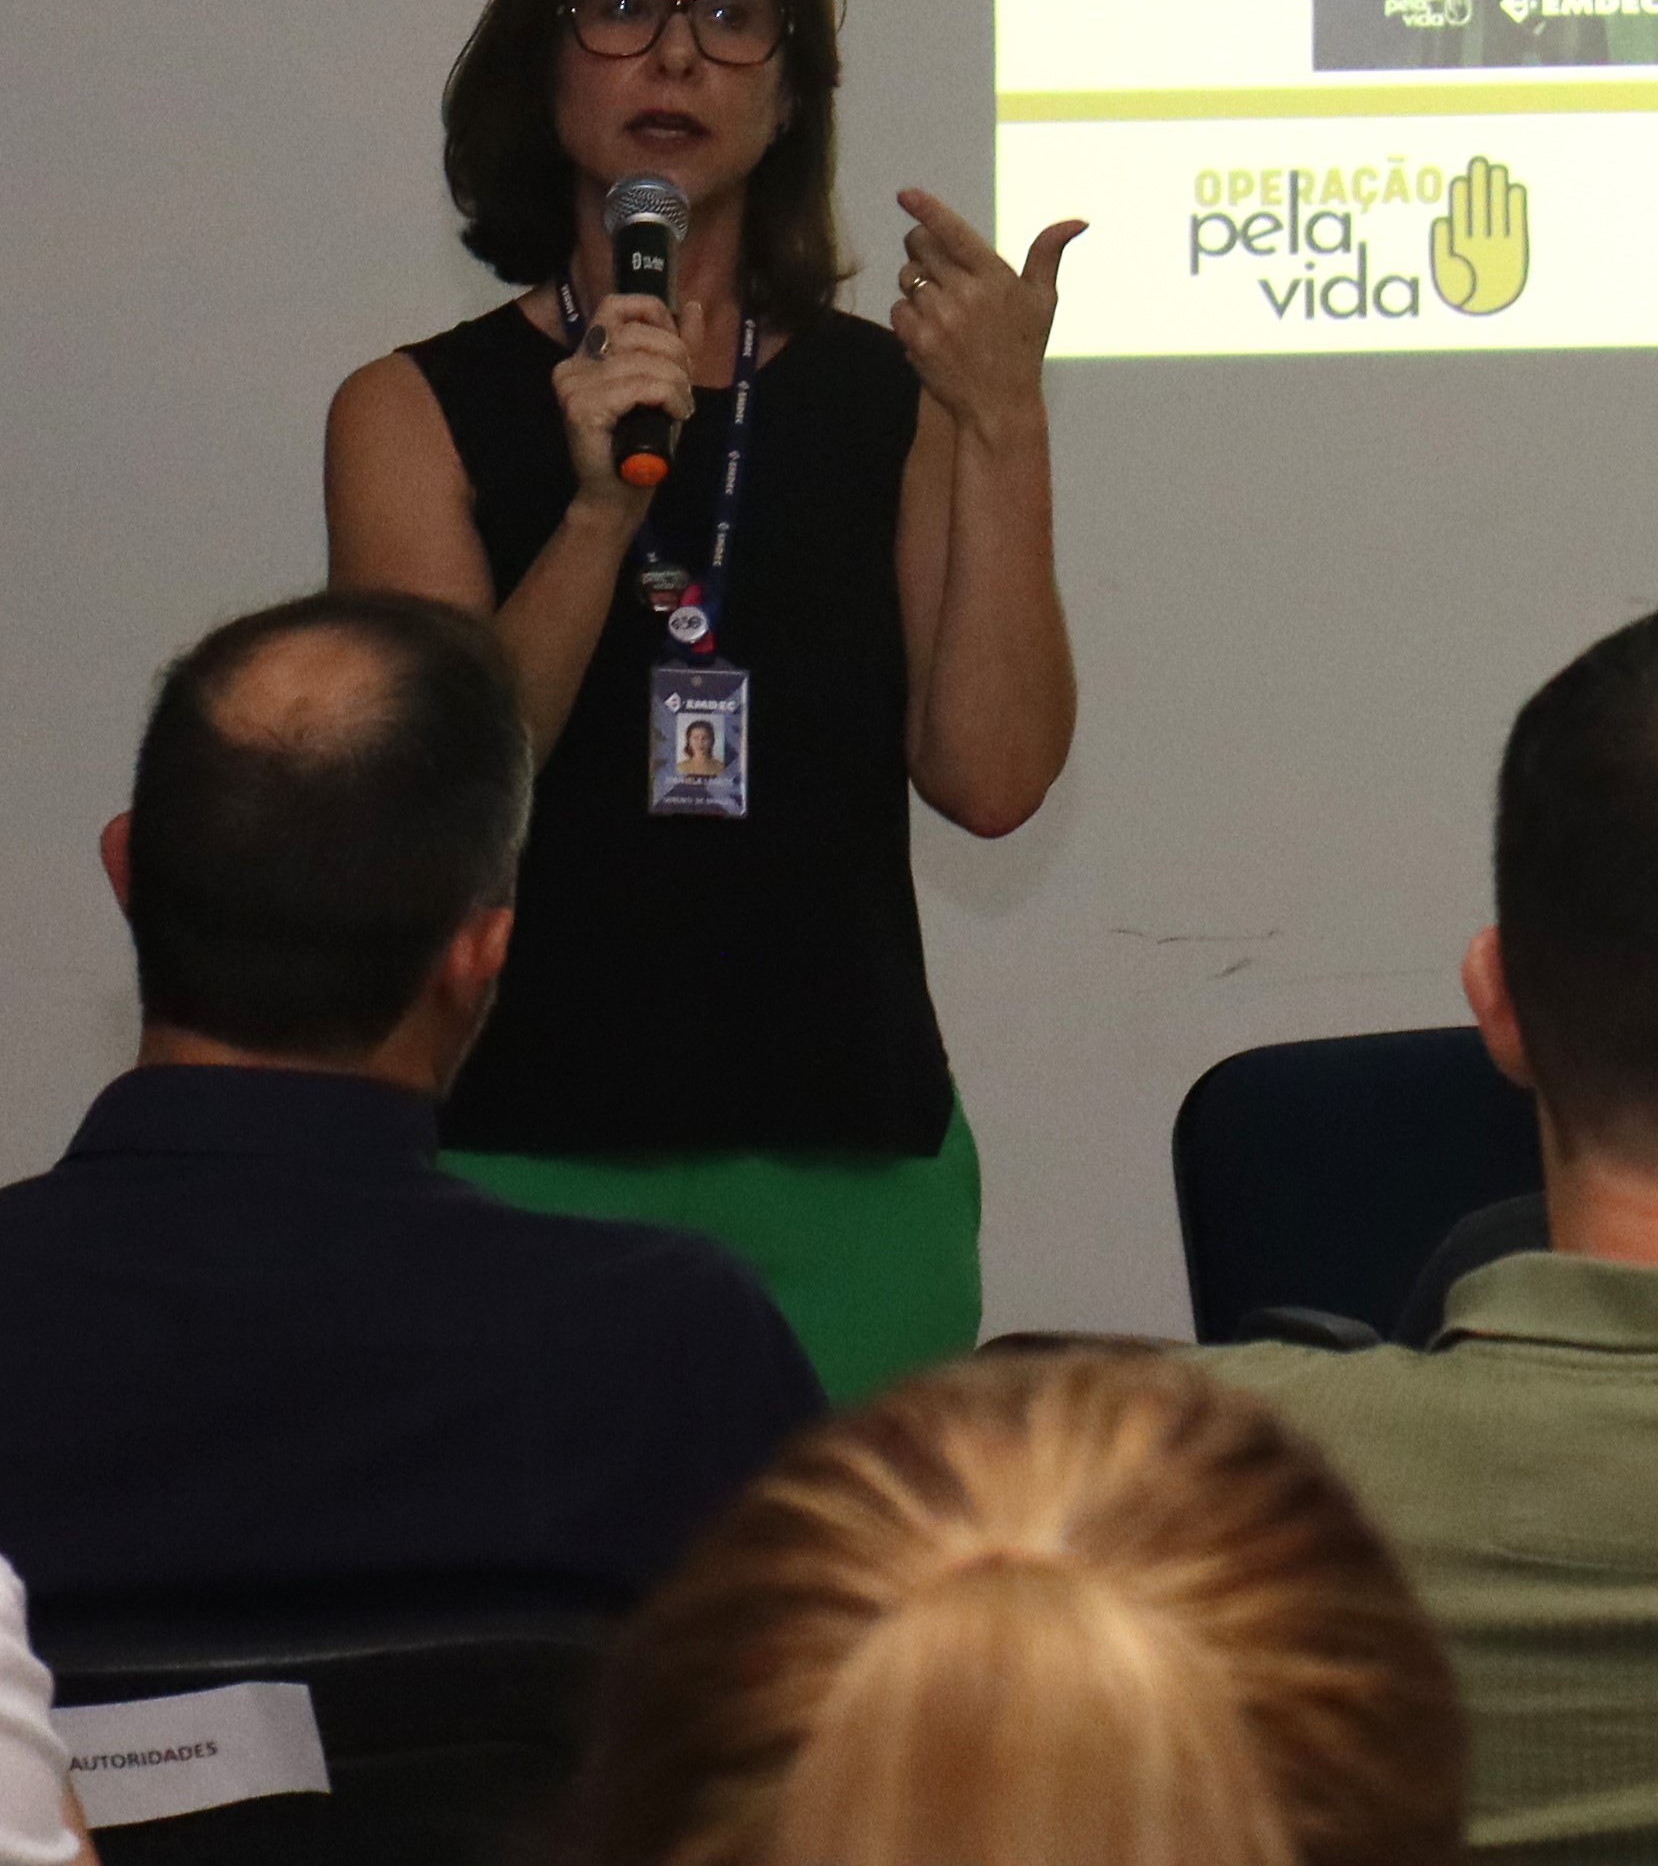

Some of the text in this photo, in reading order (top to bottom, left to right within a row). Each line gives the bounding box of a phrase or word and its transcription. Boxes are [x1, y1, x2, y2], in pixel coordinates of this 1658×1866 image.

[1193, 154, 1443, 212] OPERAÇÃO
[1189, 170, 1354, 276] pela
[1257, 241, 1421, 321] vida
[68, 1739, 218, 1773] AUTORIDADES
